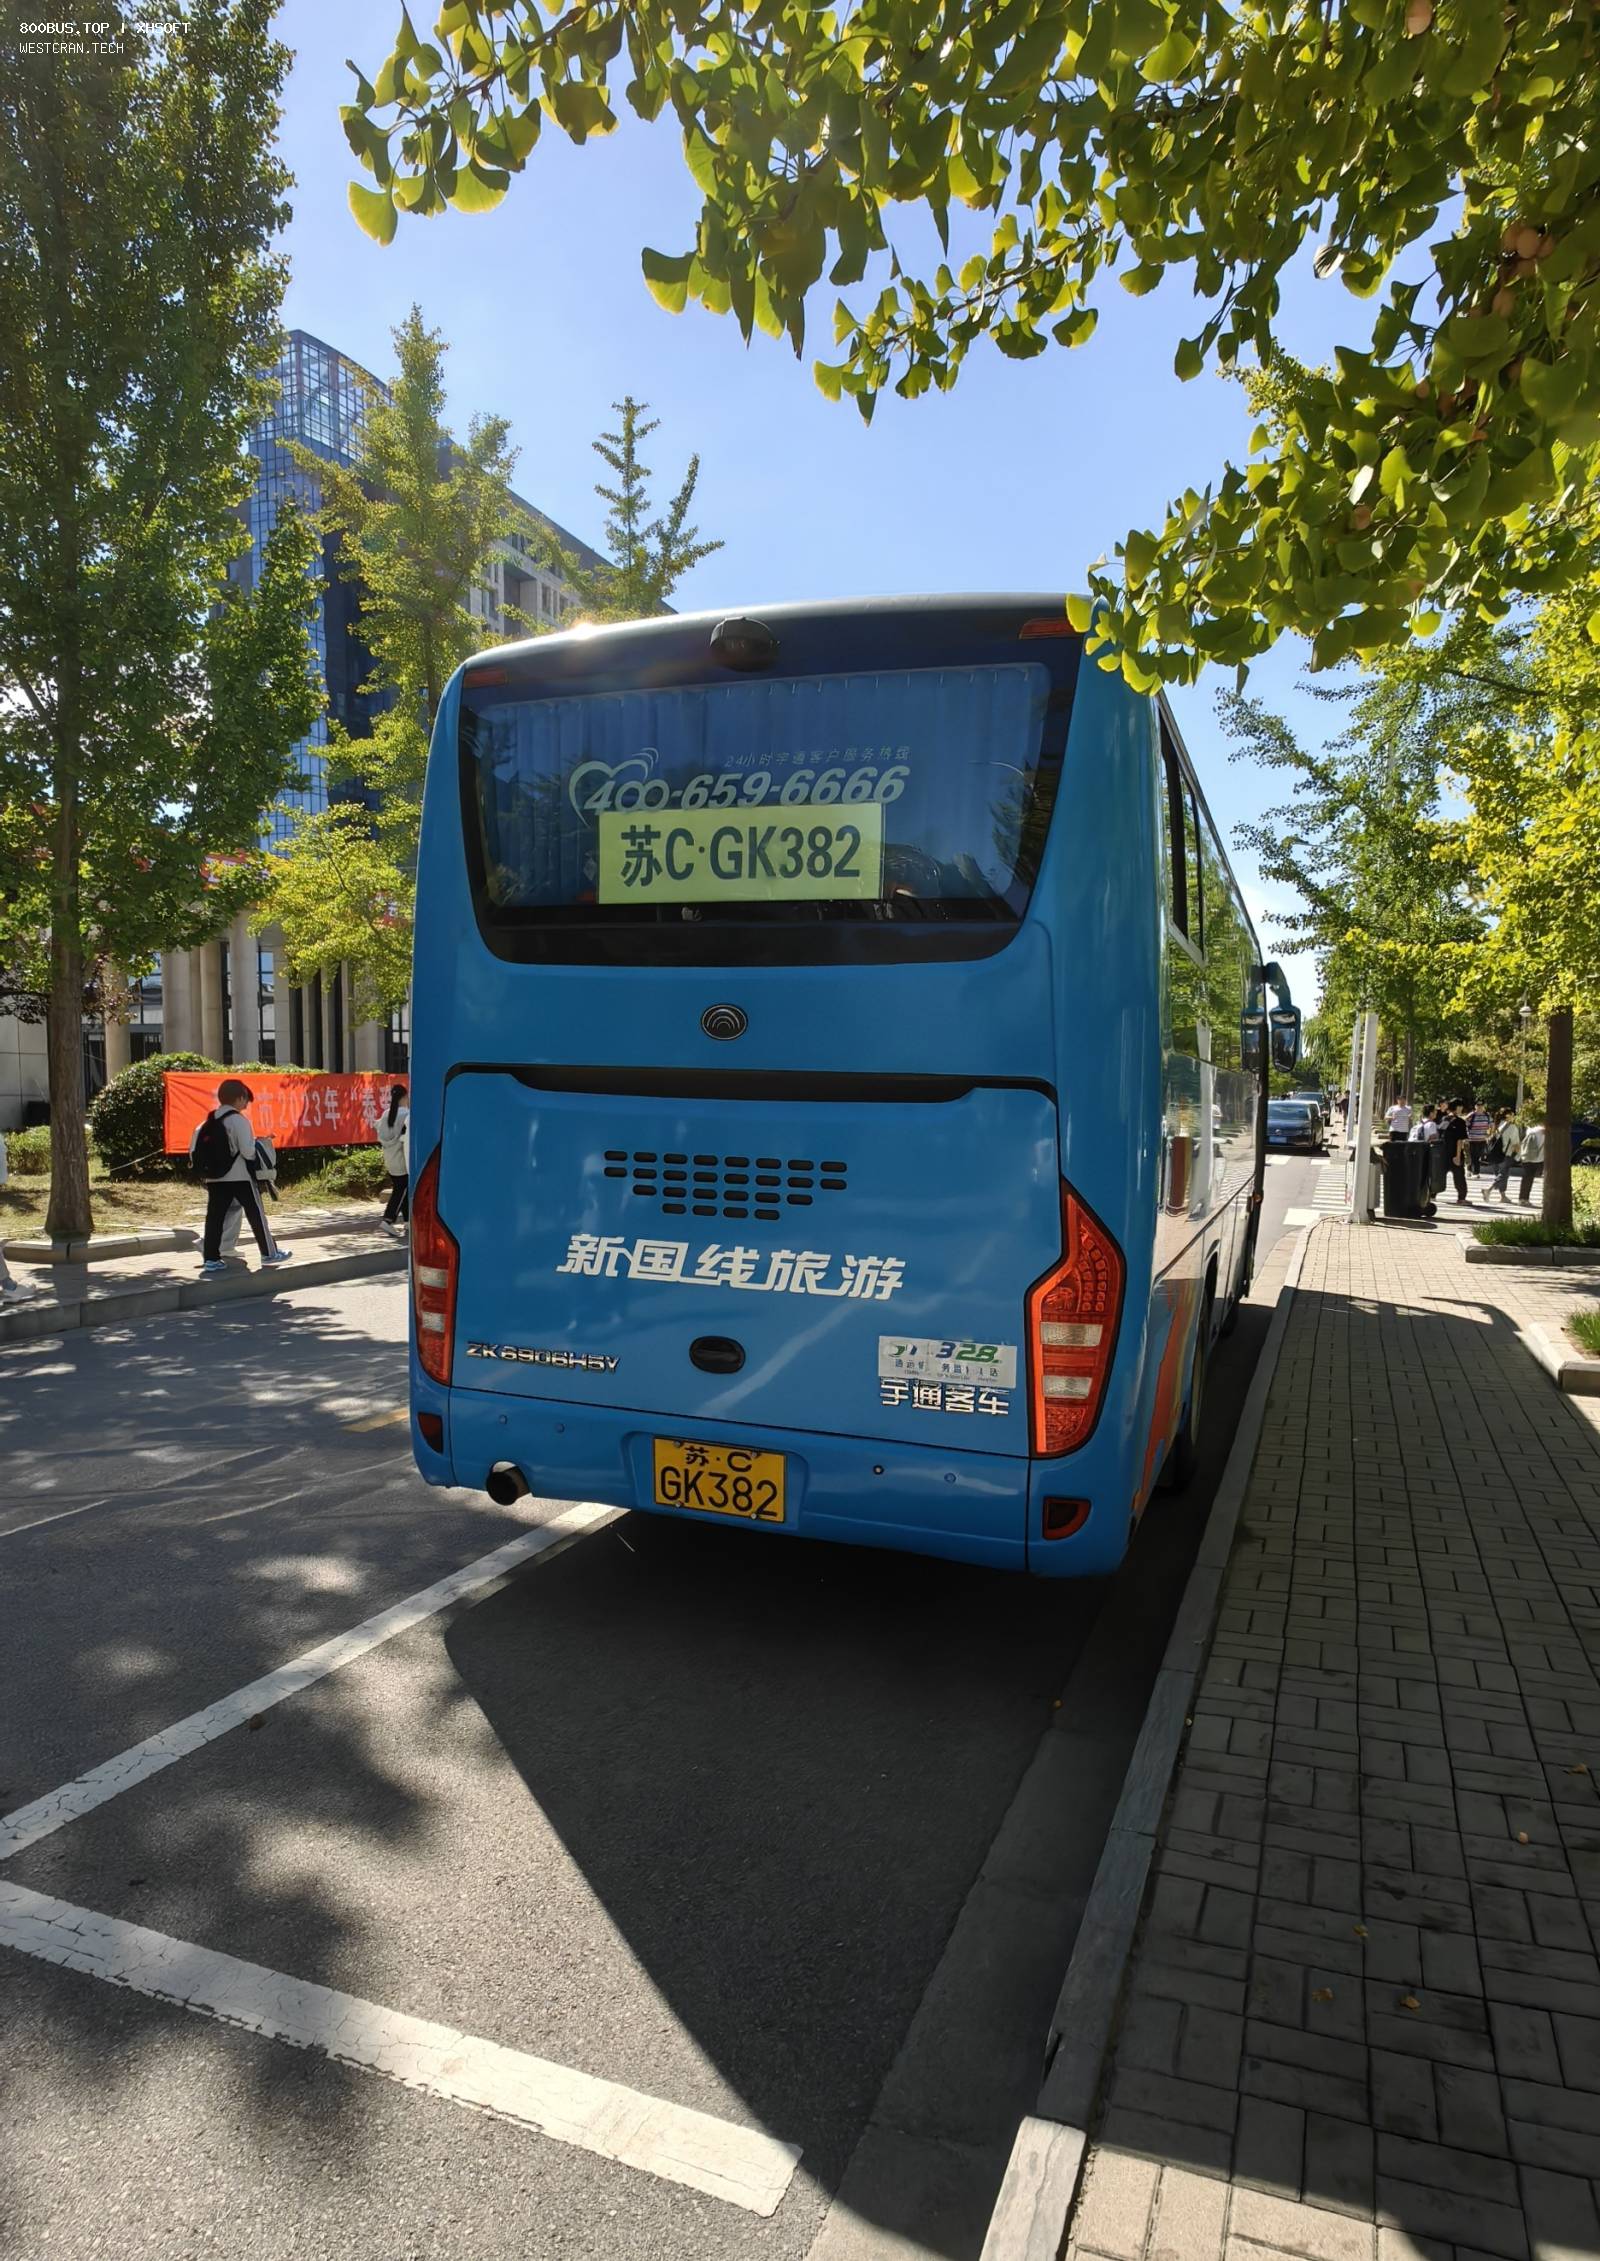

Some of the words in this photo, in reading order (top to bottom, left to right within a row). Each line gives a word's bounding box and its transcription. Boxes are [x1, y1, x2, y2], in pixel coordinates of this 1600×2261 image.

[583, 765, 911, 815] 400-659-6666
[556, 1233, 906, 1301] 新国线旅游
[880, 1378, 1010, 1415] 宇通客车
[660, 1465, 778, 1517] GK382
